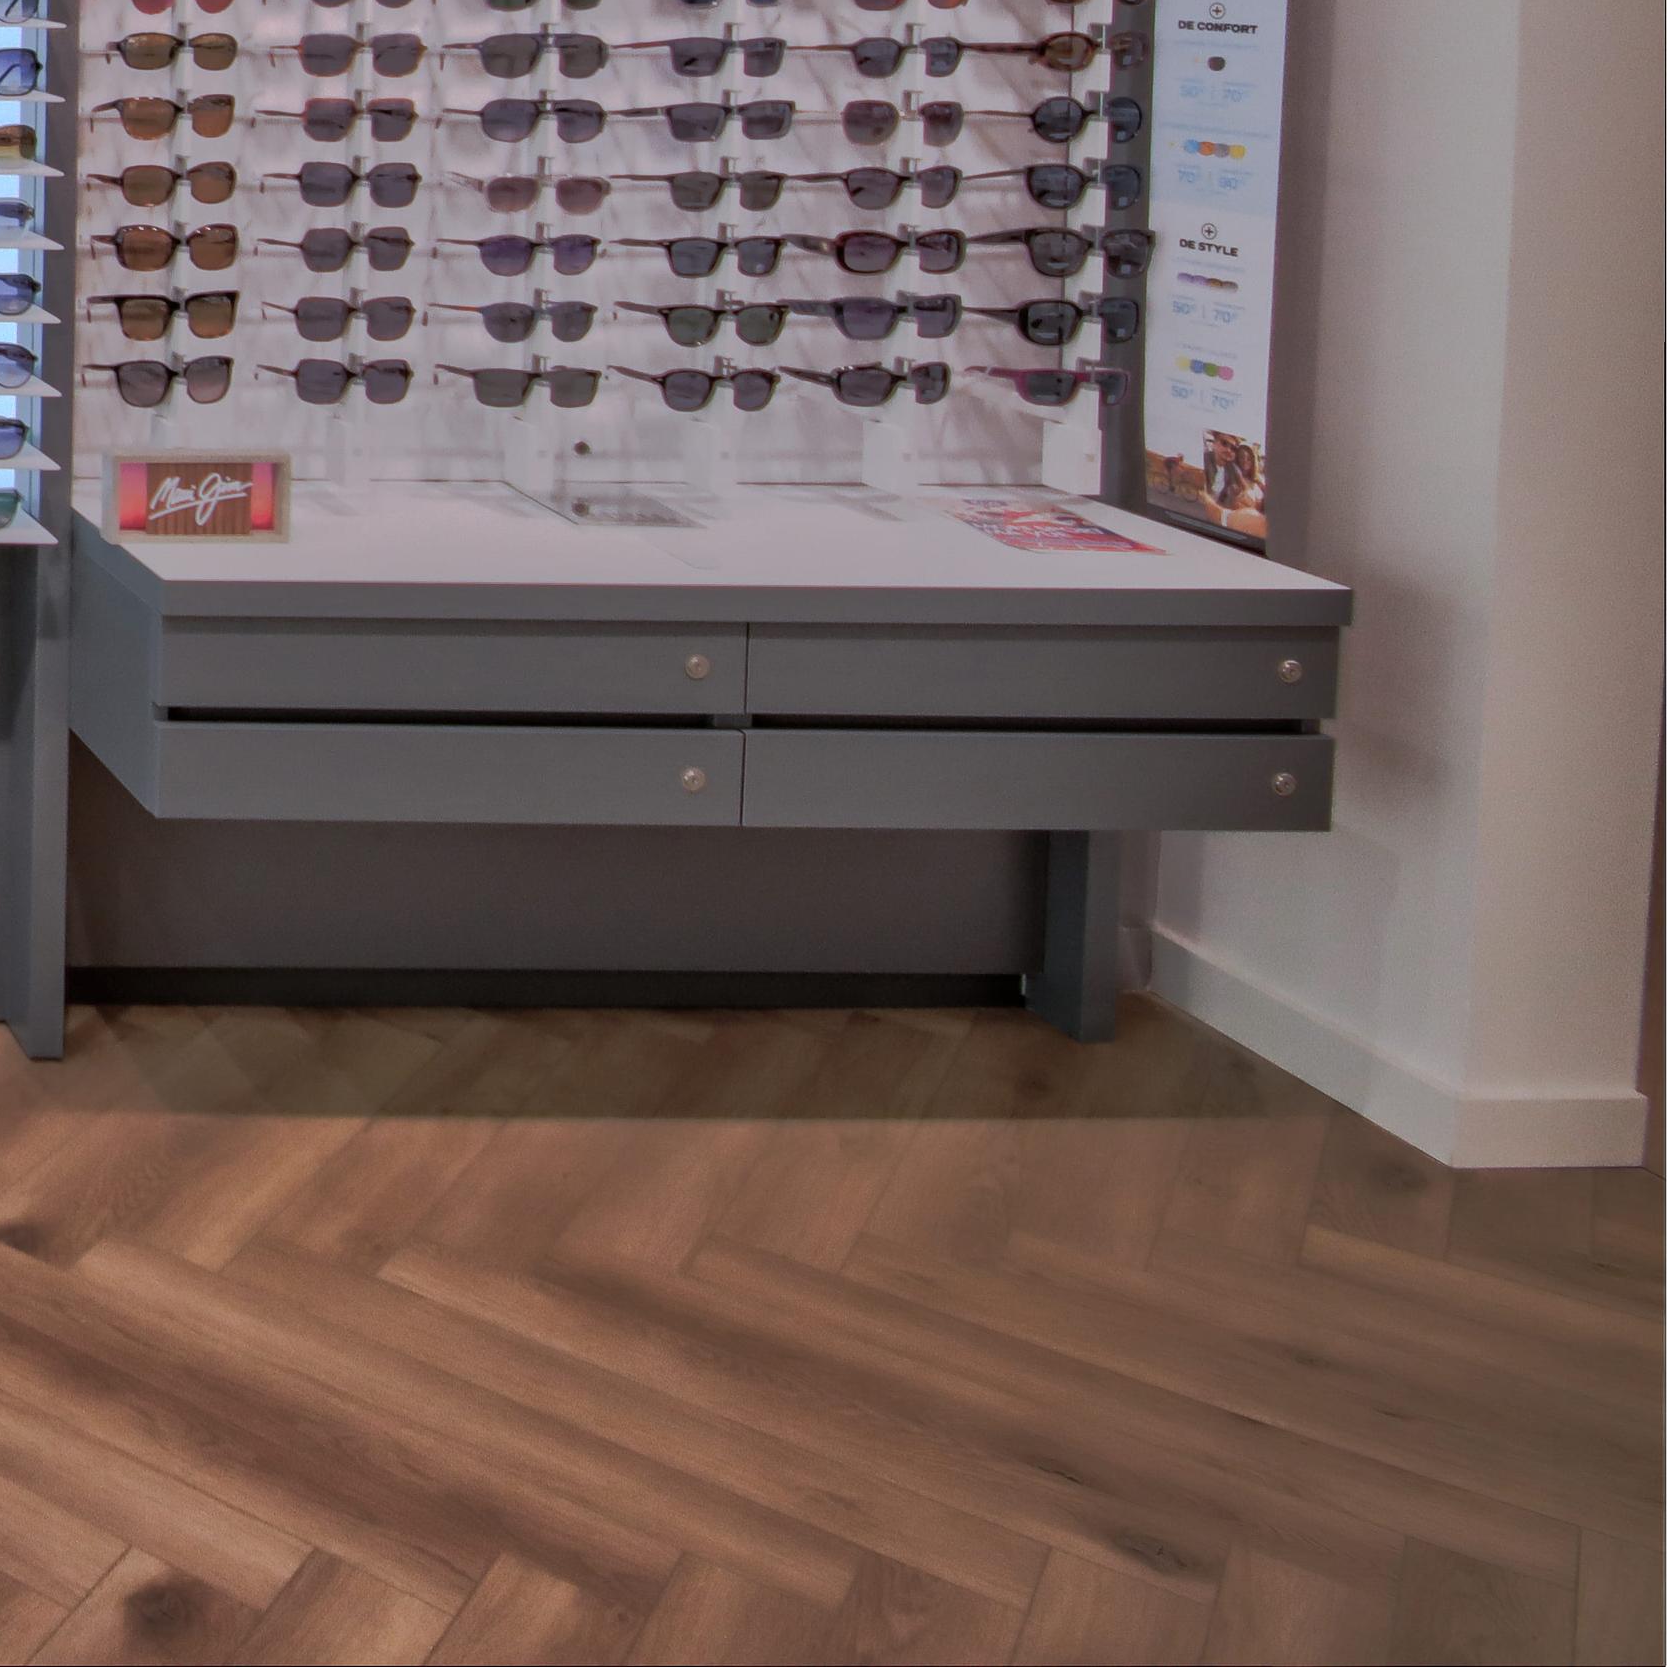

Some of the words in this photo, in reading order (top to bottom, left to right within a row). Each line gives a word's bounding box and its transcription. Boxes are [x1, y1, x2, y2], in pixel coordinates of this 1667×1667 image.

[1178, 20, 1194, 30] DE
[1197, 21, 1258, 34] CONFORT
[1179, 238, 1196, 250] DE
[1198, 241, 1239, 257] STYLE
